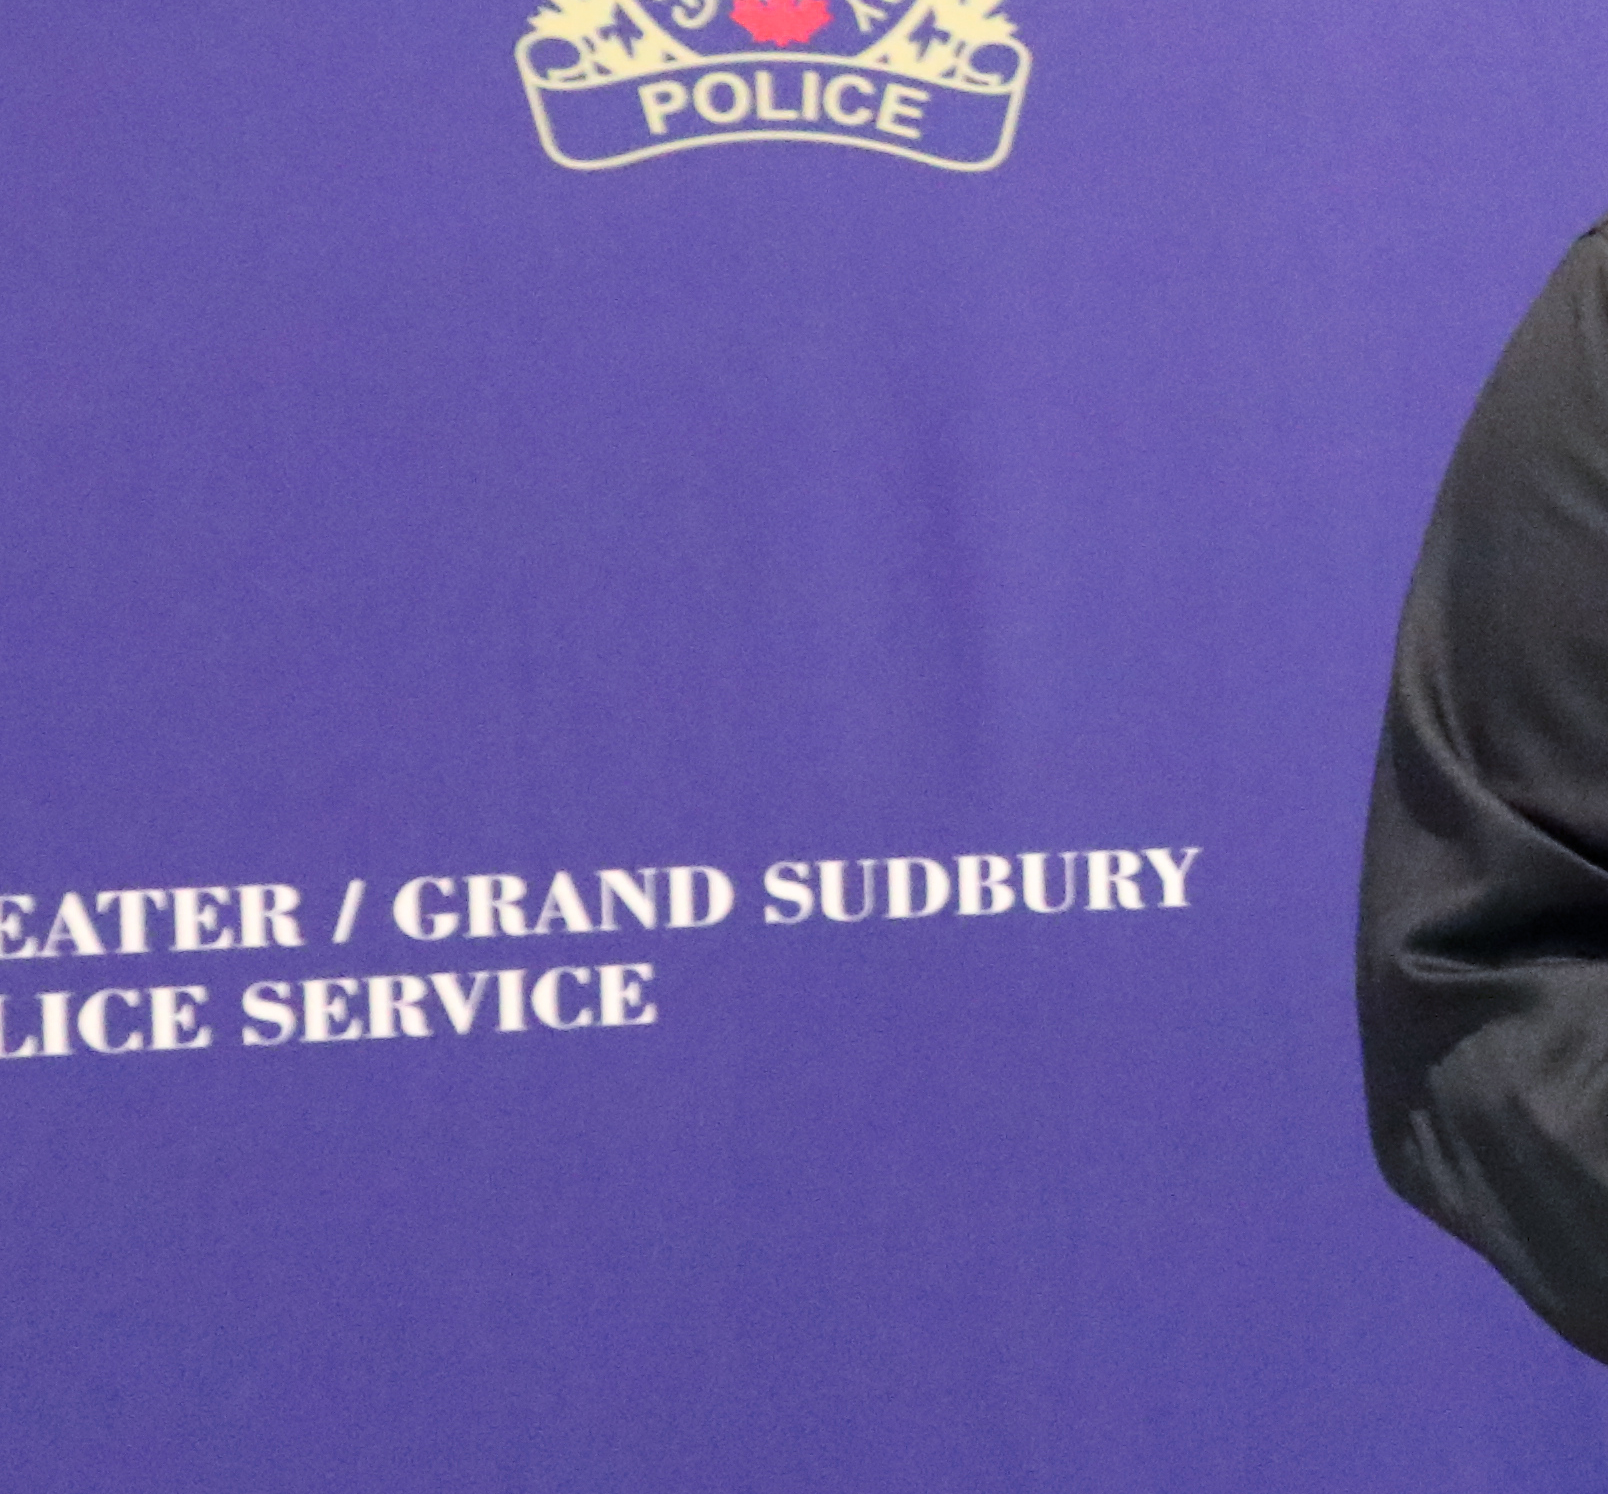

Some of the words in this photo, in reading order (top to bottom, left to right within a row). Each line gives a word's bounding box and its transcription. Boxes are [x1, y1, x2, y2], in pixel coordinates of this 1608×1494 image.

[638, 70, 930, 139] POLICE
[332, 879, 365, 943] /
[393, 866, 734, 940] GRAND
[764, 847, 1200, 923] SUDBURY
[242, 963, 657, 1046] SERVICE
